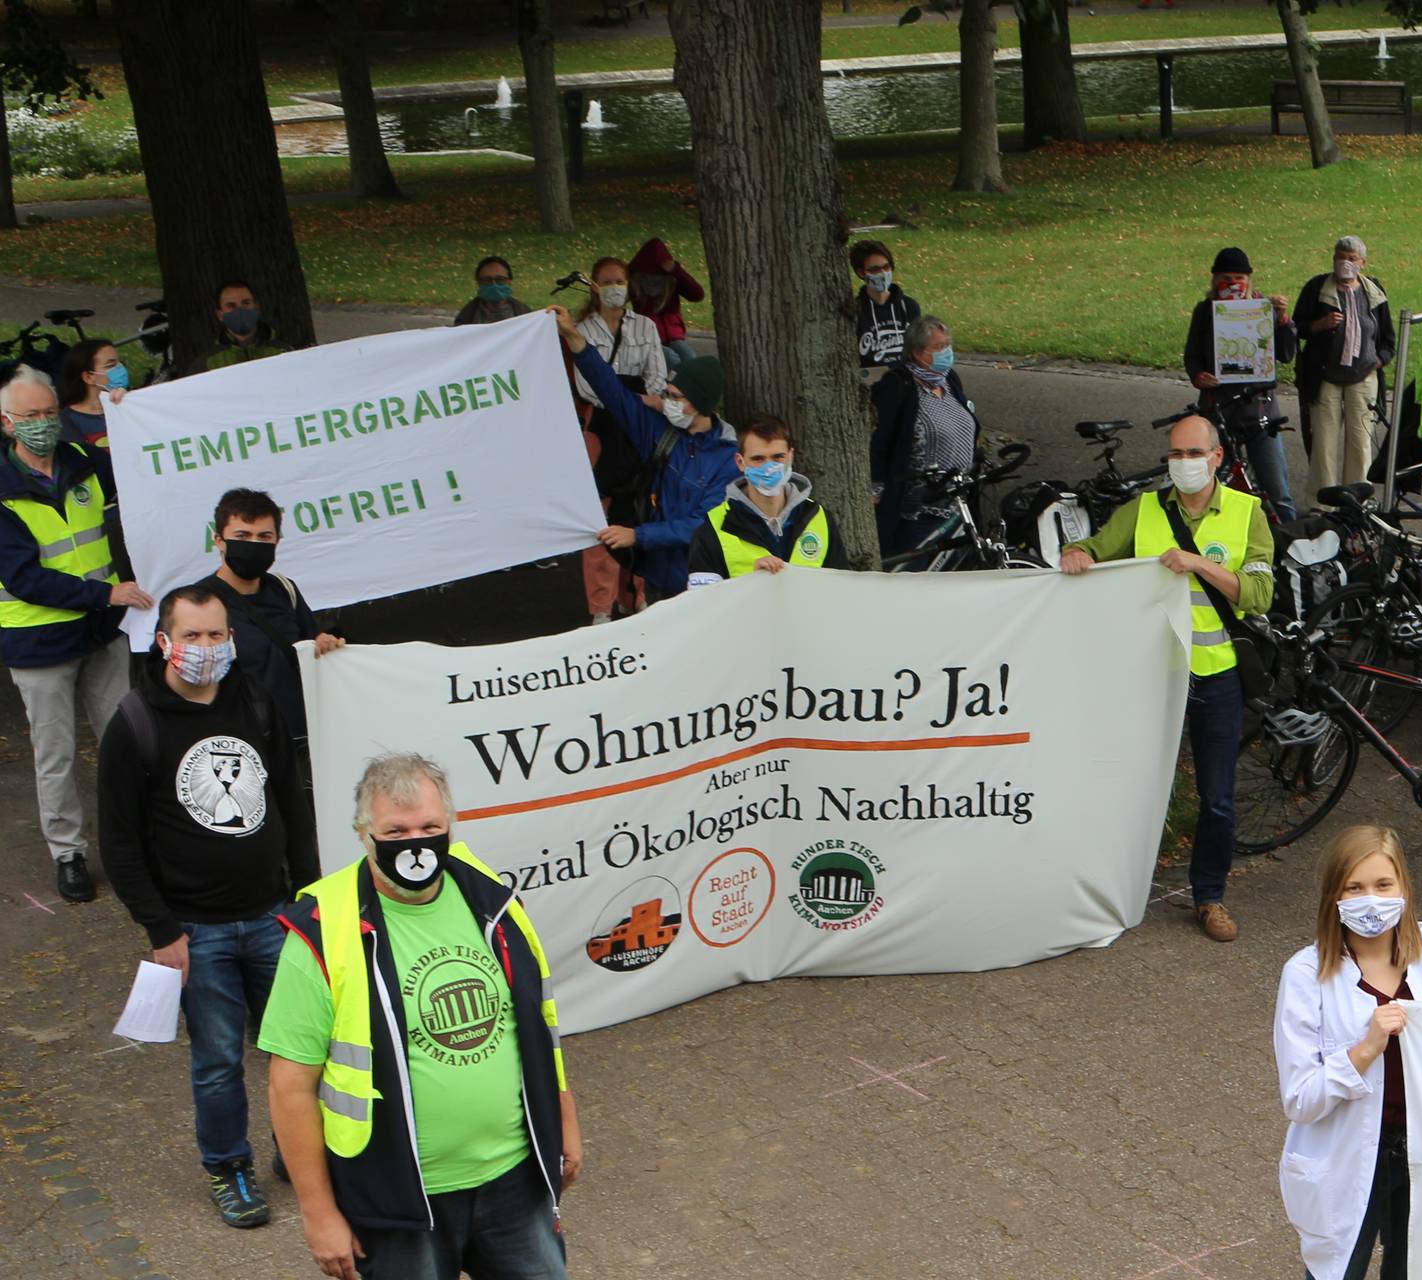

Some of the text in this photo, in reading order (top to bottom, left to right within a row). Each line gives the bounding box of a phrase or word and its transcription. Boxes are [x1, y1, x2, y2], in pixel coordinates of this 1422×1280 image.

[142, 368, 521, 476] TEMPLERGRABEN
[205, 470, 461, 553] OFREI !
[446, 647, 648, 704] Luisenhöfe:
[464, 663, 1009, 785] Wohnungsbau? Ja!
[181, 744, 210, 783] CHANGE
[211, 739, 239, 751] NOT
[705, 757, 791, 794] Aber nur
[181, 786, 211, 825] SYSTEM
[497, 780, 1035, 892] ozial Ökologisch Nachhaltig
[791, 839, 886, 875] RUNDER TISCH
[709, 866, 758, 893] Recht
[720, 885, 748, 907] auf
[711, 901, 754, 928] Stadt
[788, 894, 885, 930] KLIMANOTSTAND
[817, 904, 854, 915] Aachen
[402, 945, 500, 998] RUNDER TISCH
[409, 1001, 515, 1067] KLIMANOTSTAND
[449, 1026, 488, 1045] Aachen
